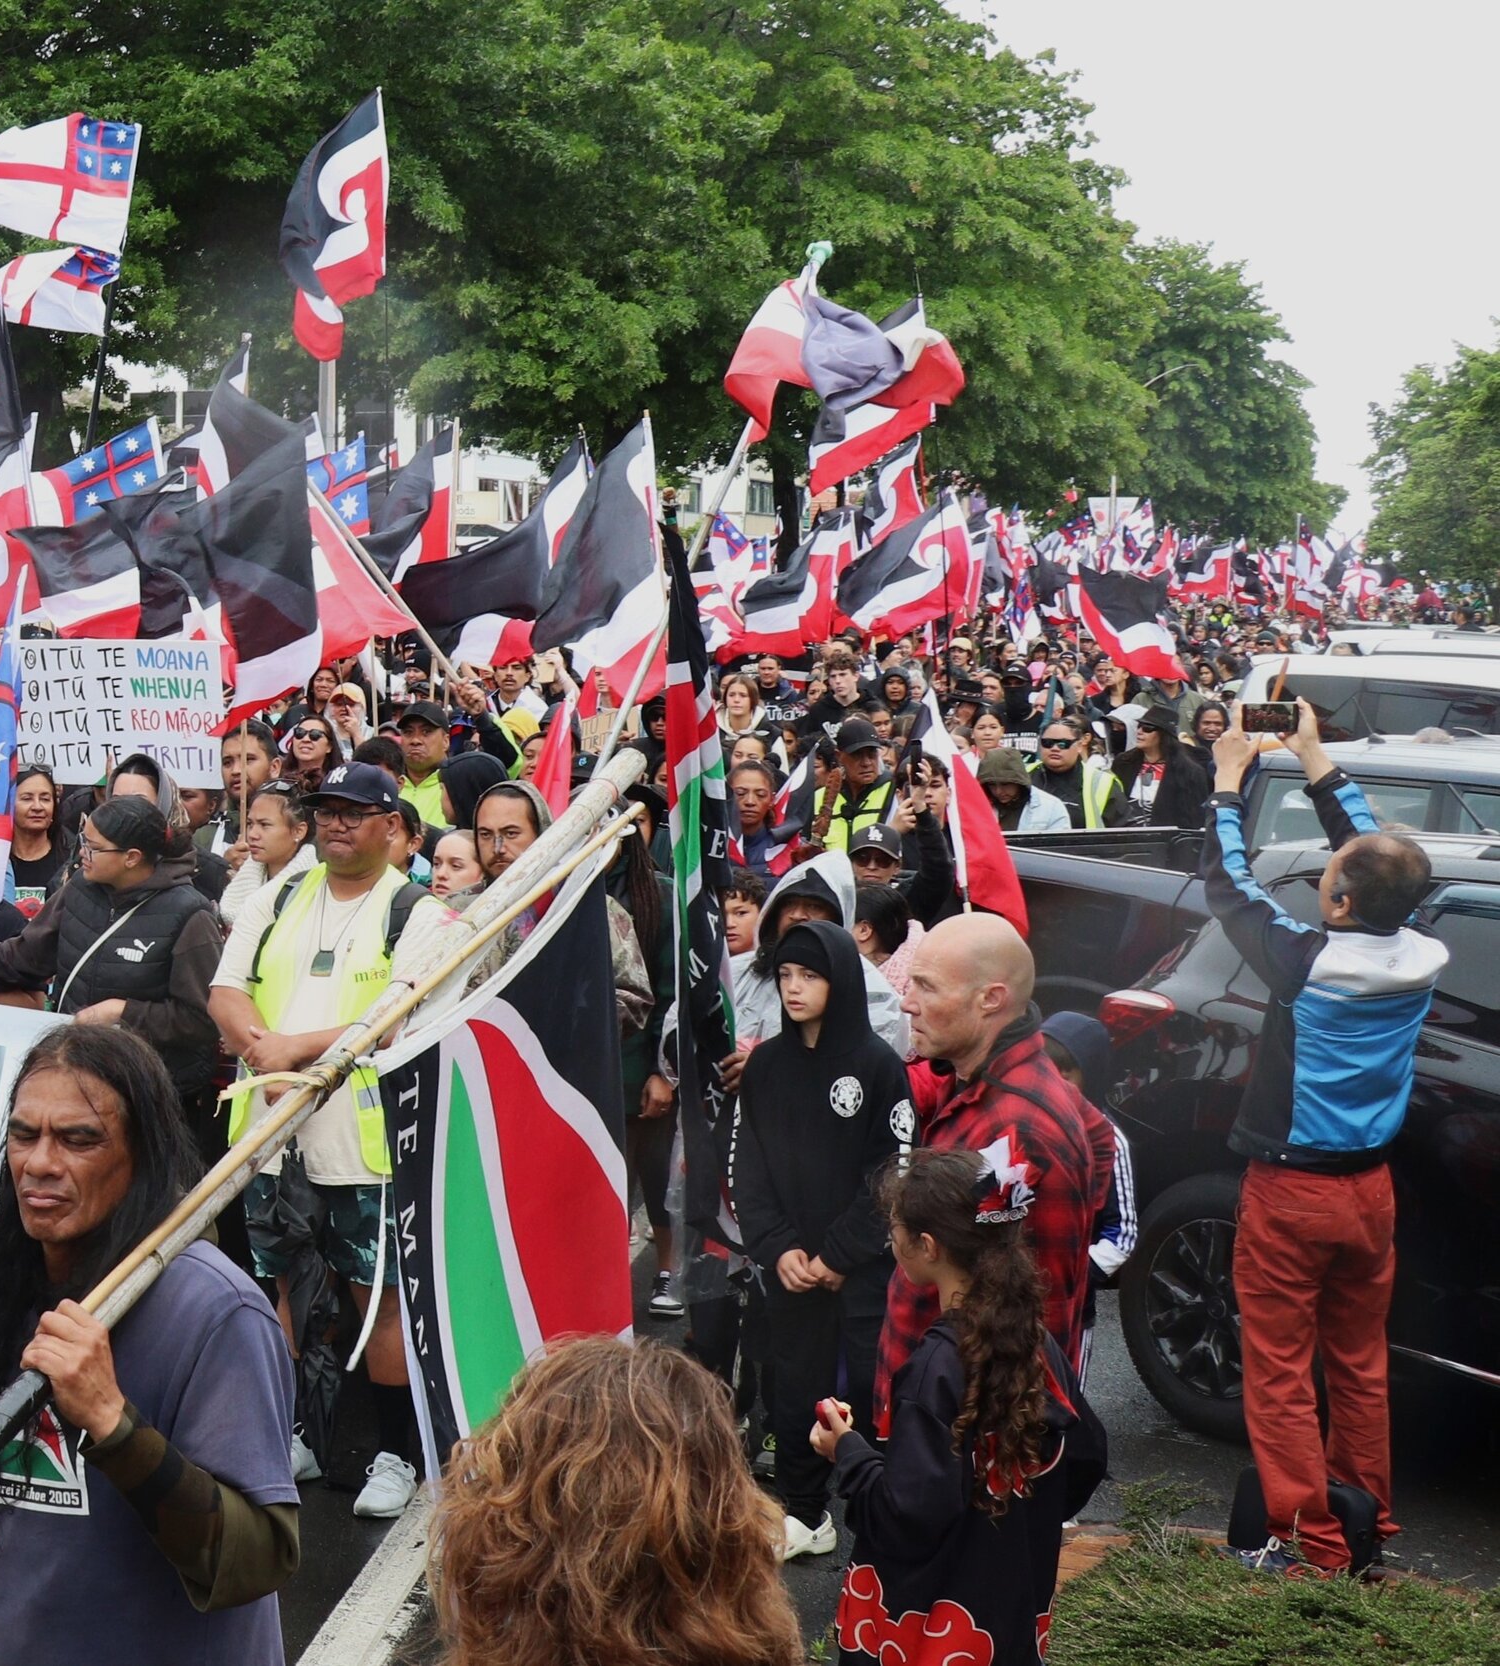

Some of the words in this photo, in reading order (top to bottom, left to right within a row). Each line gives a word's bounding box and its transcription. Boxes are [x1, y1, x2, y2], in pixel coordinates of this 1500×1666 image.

[20, 645, 86, 671] OITŪ
[97, 647, 126, 668] TE
[136, 647, 209, 671] MOANA
[21, 676, 86, 702] OITŪ
[96, 676, 124, 699] TE
[130, 676, 208, 701] WHENUA
[96, 708, 125, 732] TE
[130, 708, 161, 731] REO
[16, 741, 92, 768] TOITŪ
[398, 1070, 420, 1165] TE
[49, 1490, 80, 1506] 2005
